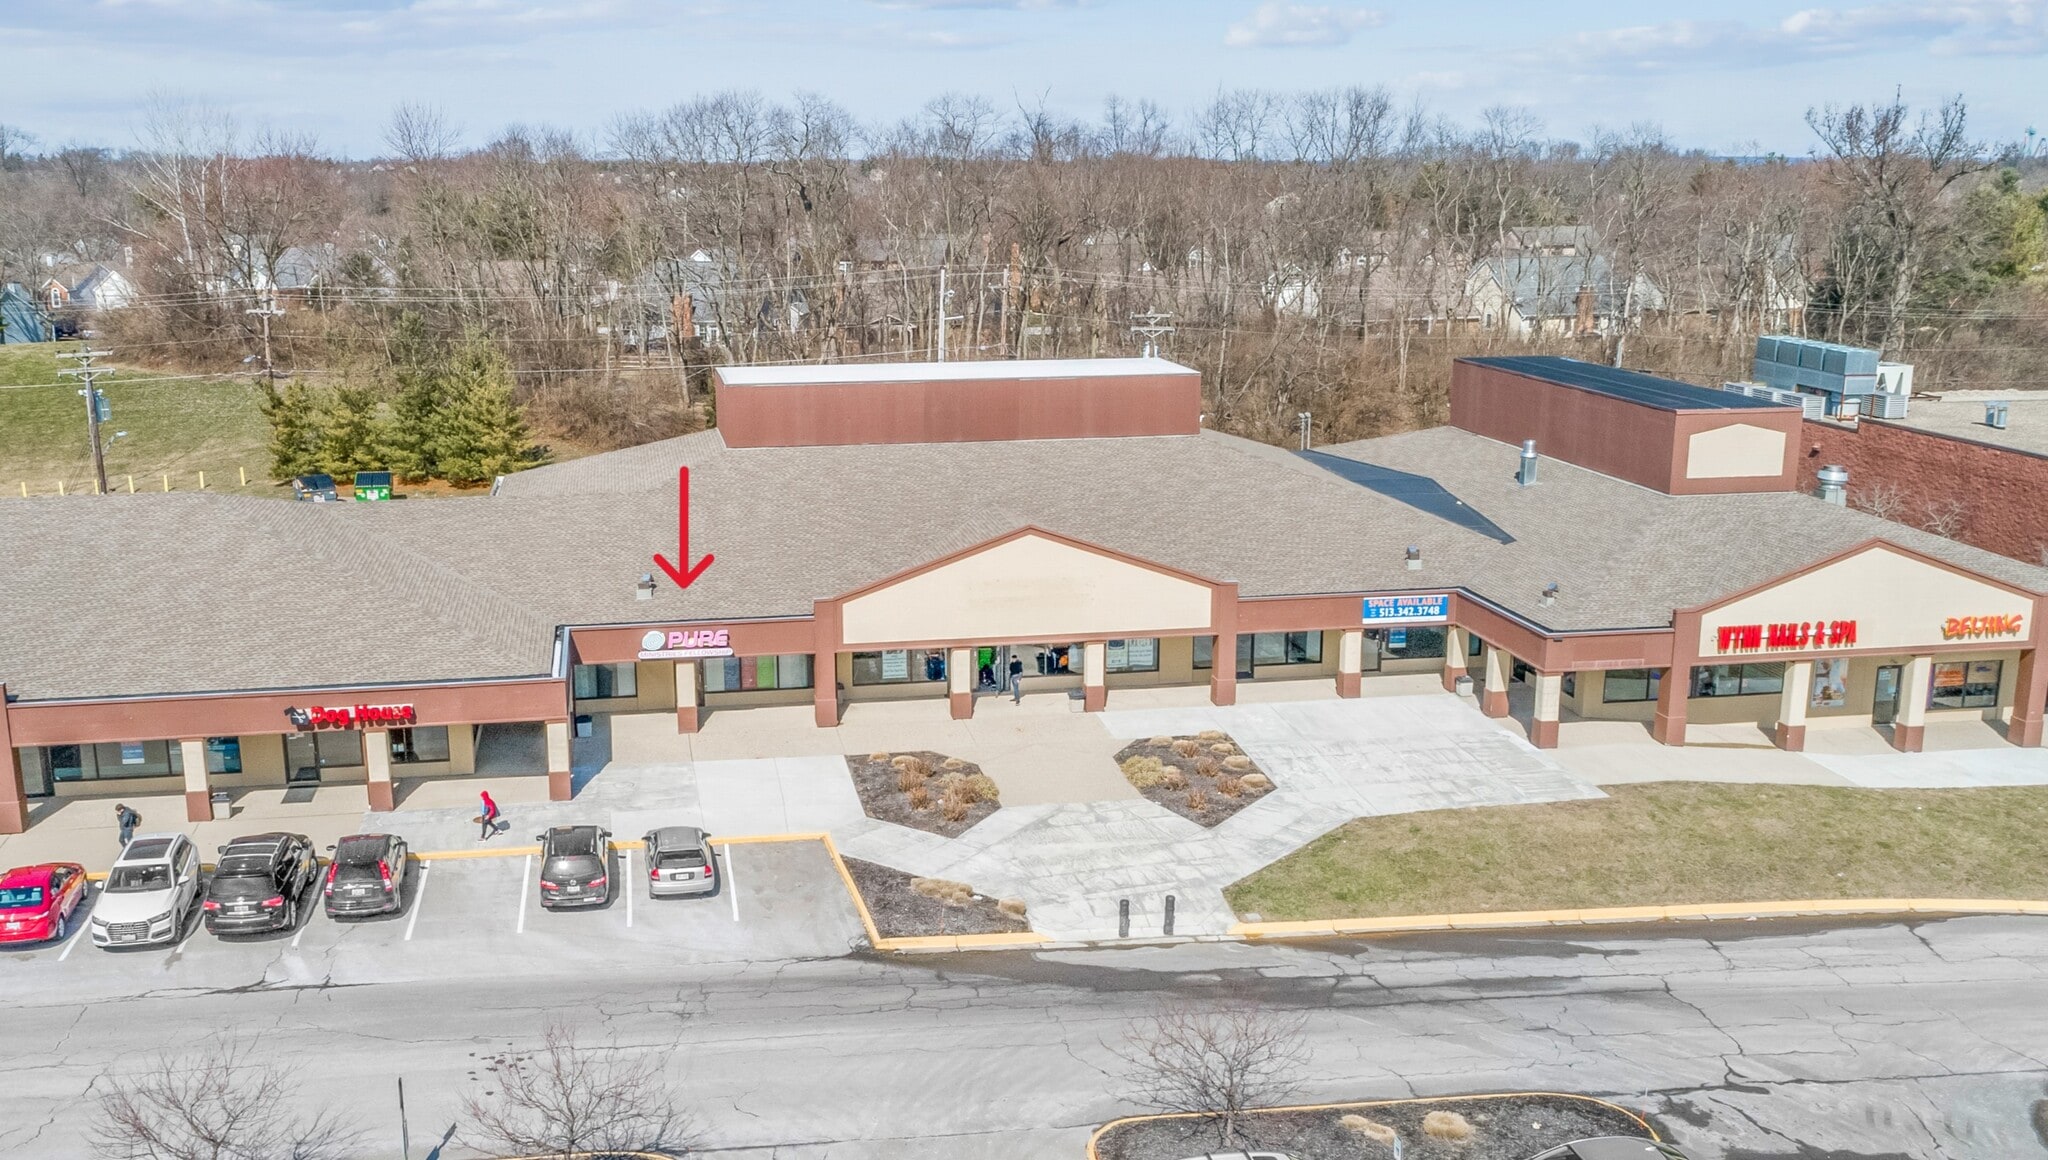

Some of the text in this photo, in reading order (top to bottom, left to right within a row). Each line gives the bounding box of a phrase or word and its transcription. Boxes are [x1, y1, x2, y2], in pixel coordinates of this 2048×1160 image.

[1368, 597, 1443, 608] SPACE AVAILABLE
[1379, 606, 1440, 617] 513.342.3748
[1768, 621, 1811, 647] NAILS
[1815, 621, 1825, 646] &
[1830, 620, 1857, 645] SPA
[1946, 613, 2023, 636] BEIJING
[667, 629, 729, 649] PURE
[684, 649, 732, 657] FELLOWSHIP
[311, 703, 412, 726] Dog House
